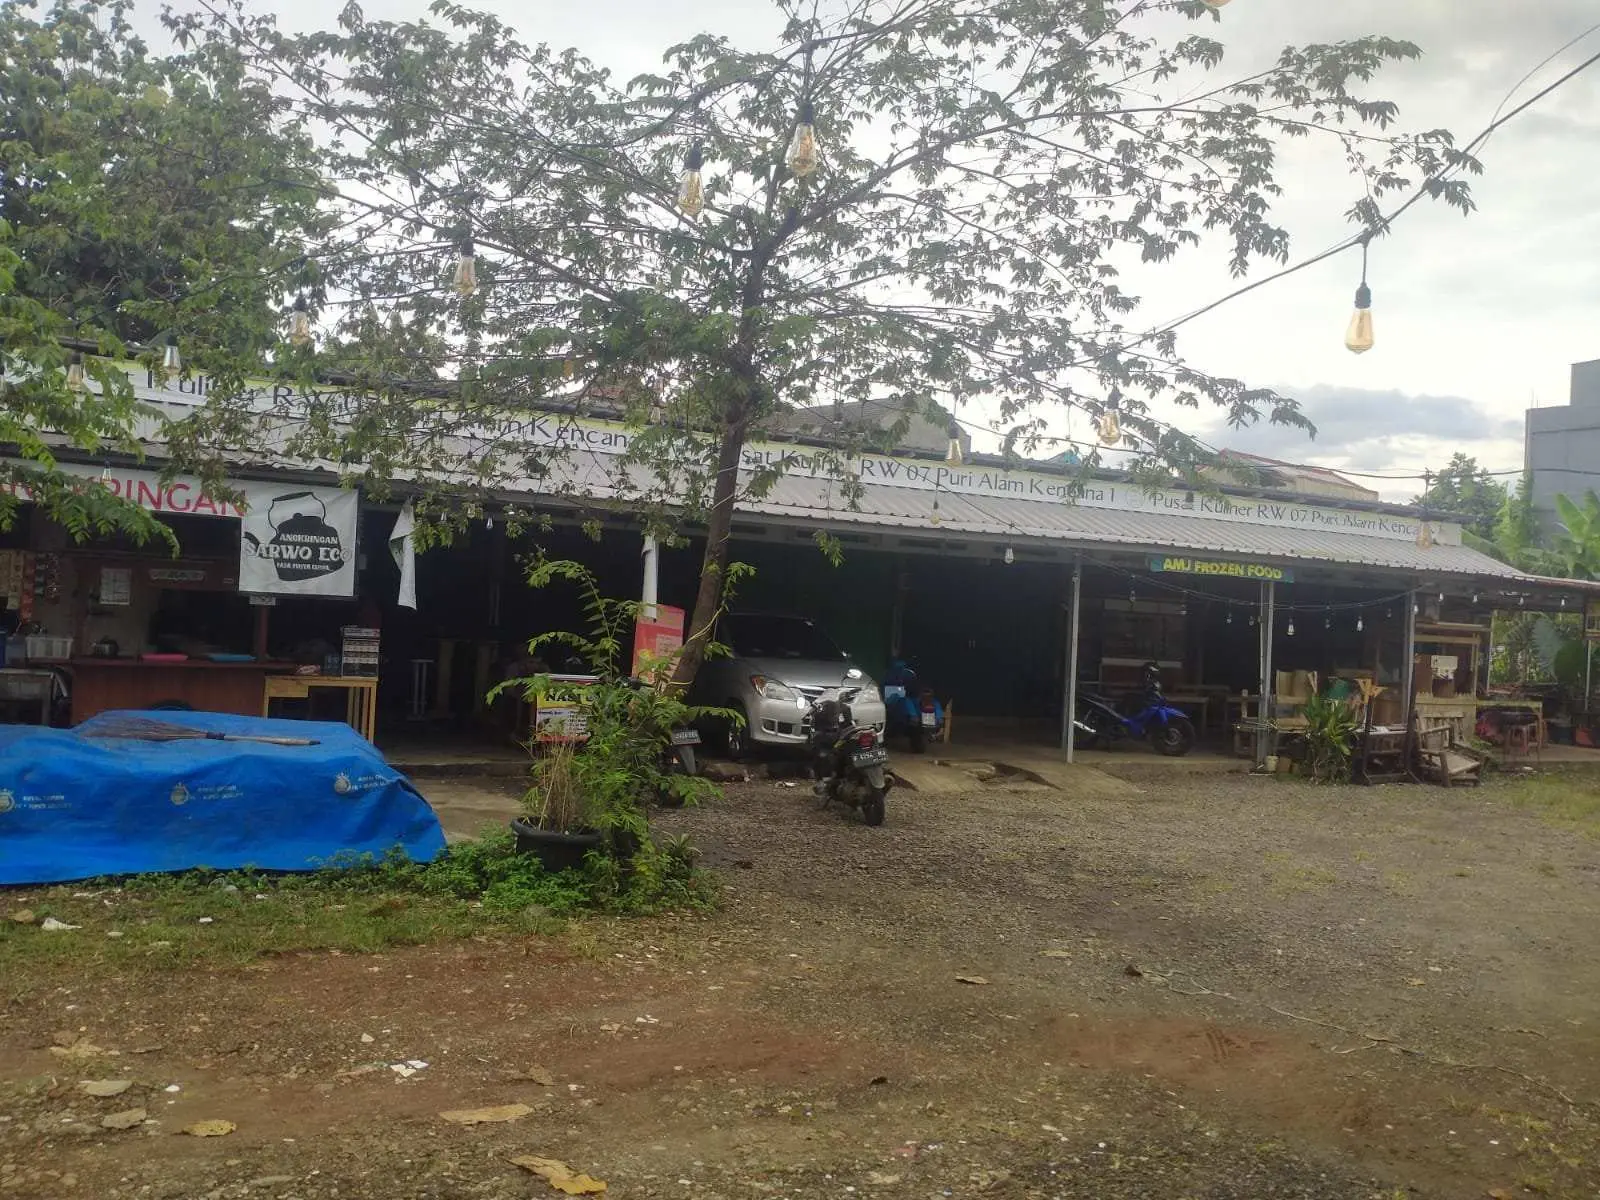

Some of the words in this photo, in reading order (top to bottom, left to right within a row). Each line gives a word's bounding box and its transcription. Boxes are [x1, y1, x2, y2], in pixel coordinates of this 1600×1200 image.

[861, 459, 901, 479] RW
[907, 465, 930, 482] 07
[936, 467, 973, 487] Puri
[978, 472, 1024, 494] Alam
[1257, 504, 1287, 520] RW
[1290, 508, 1308, 523] 07
[1311, 510, 1338, 526] Puri
[1342, 514, 1376, 530] Alam
[244, 541, 313, 561] SARWO
[1163, 558, 1191, 571] AMJ
[1194, 560, 1244, 576] FROZEN
[1247, 564, 1282, 580] FOOD
